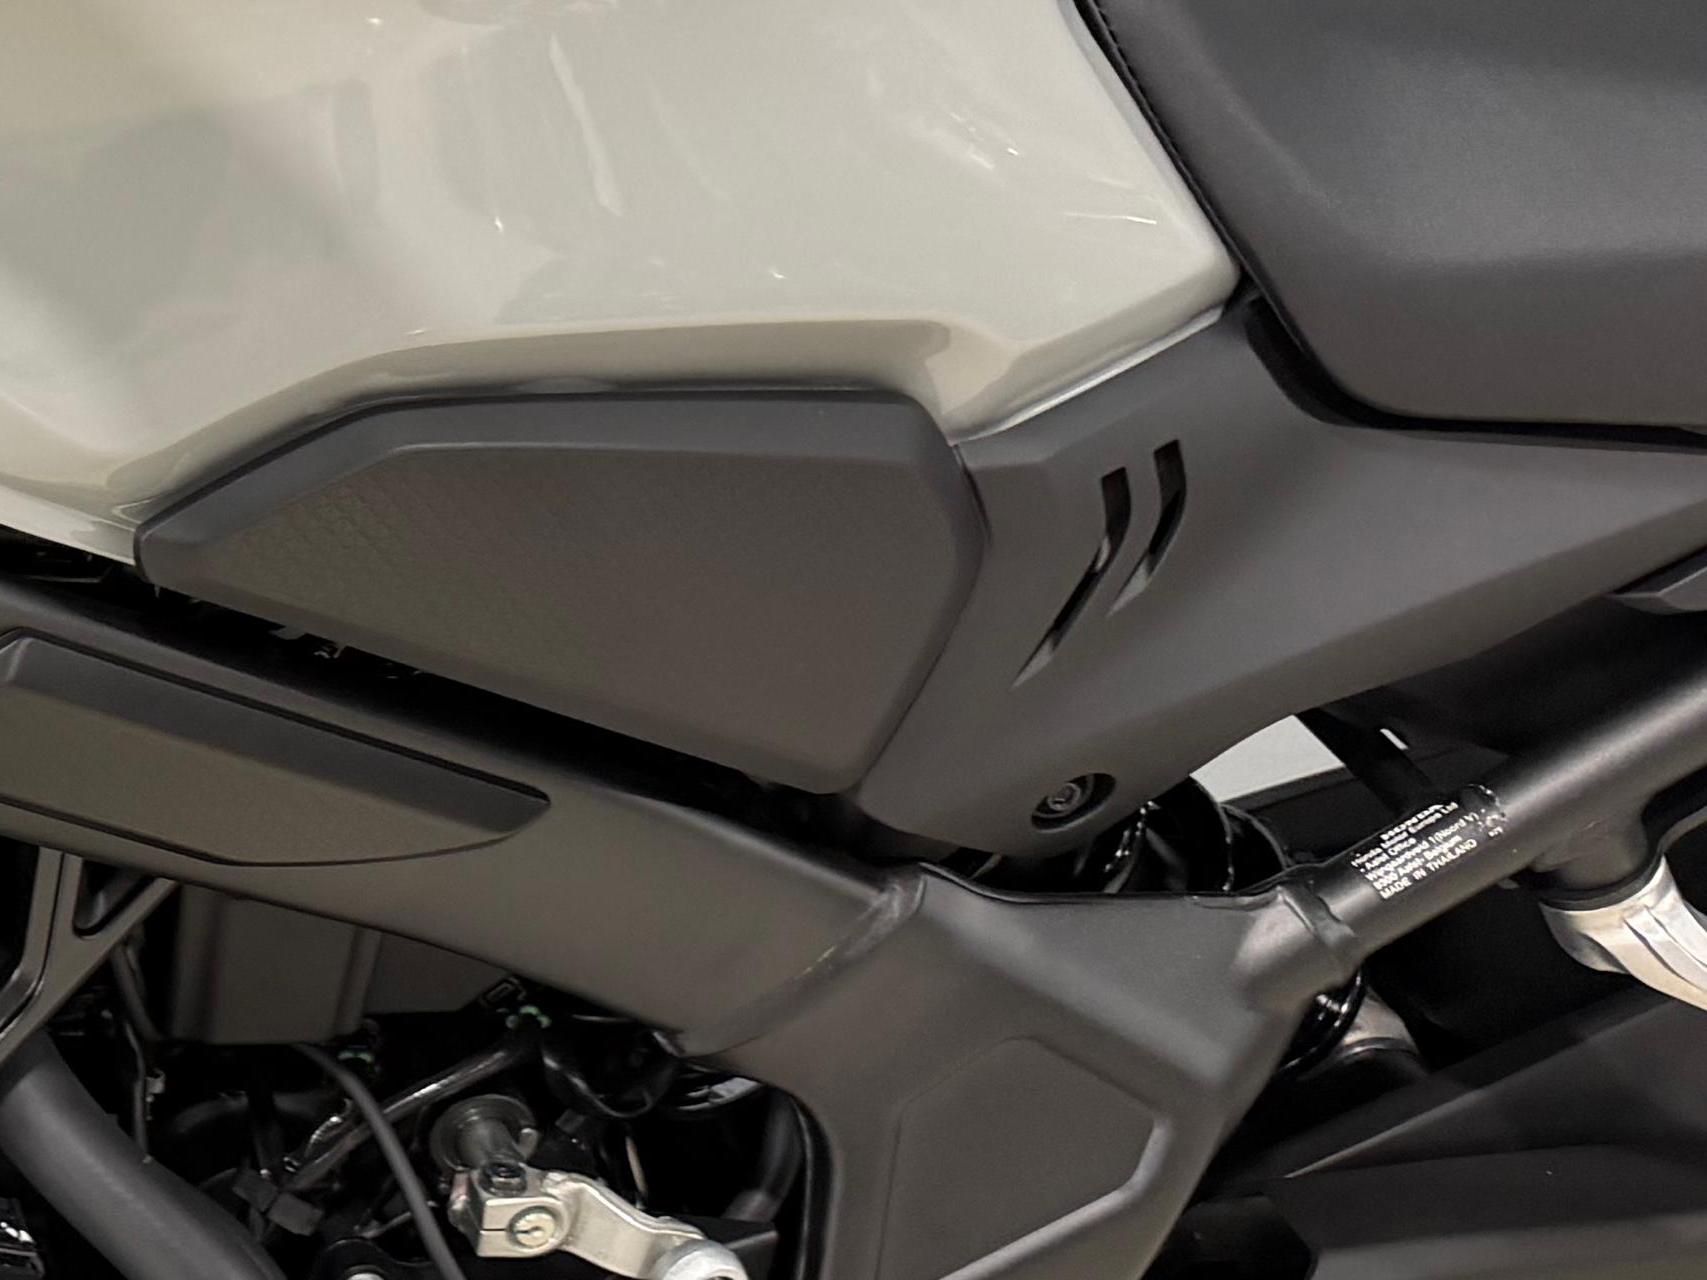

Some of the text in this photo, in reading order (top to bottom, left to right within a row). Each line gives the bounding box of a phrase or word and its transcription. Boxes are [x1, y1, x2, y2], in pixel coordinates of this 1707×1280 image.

[1379, 838, 1478, 900] MADE IN THAILAND
